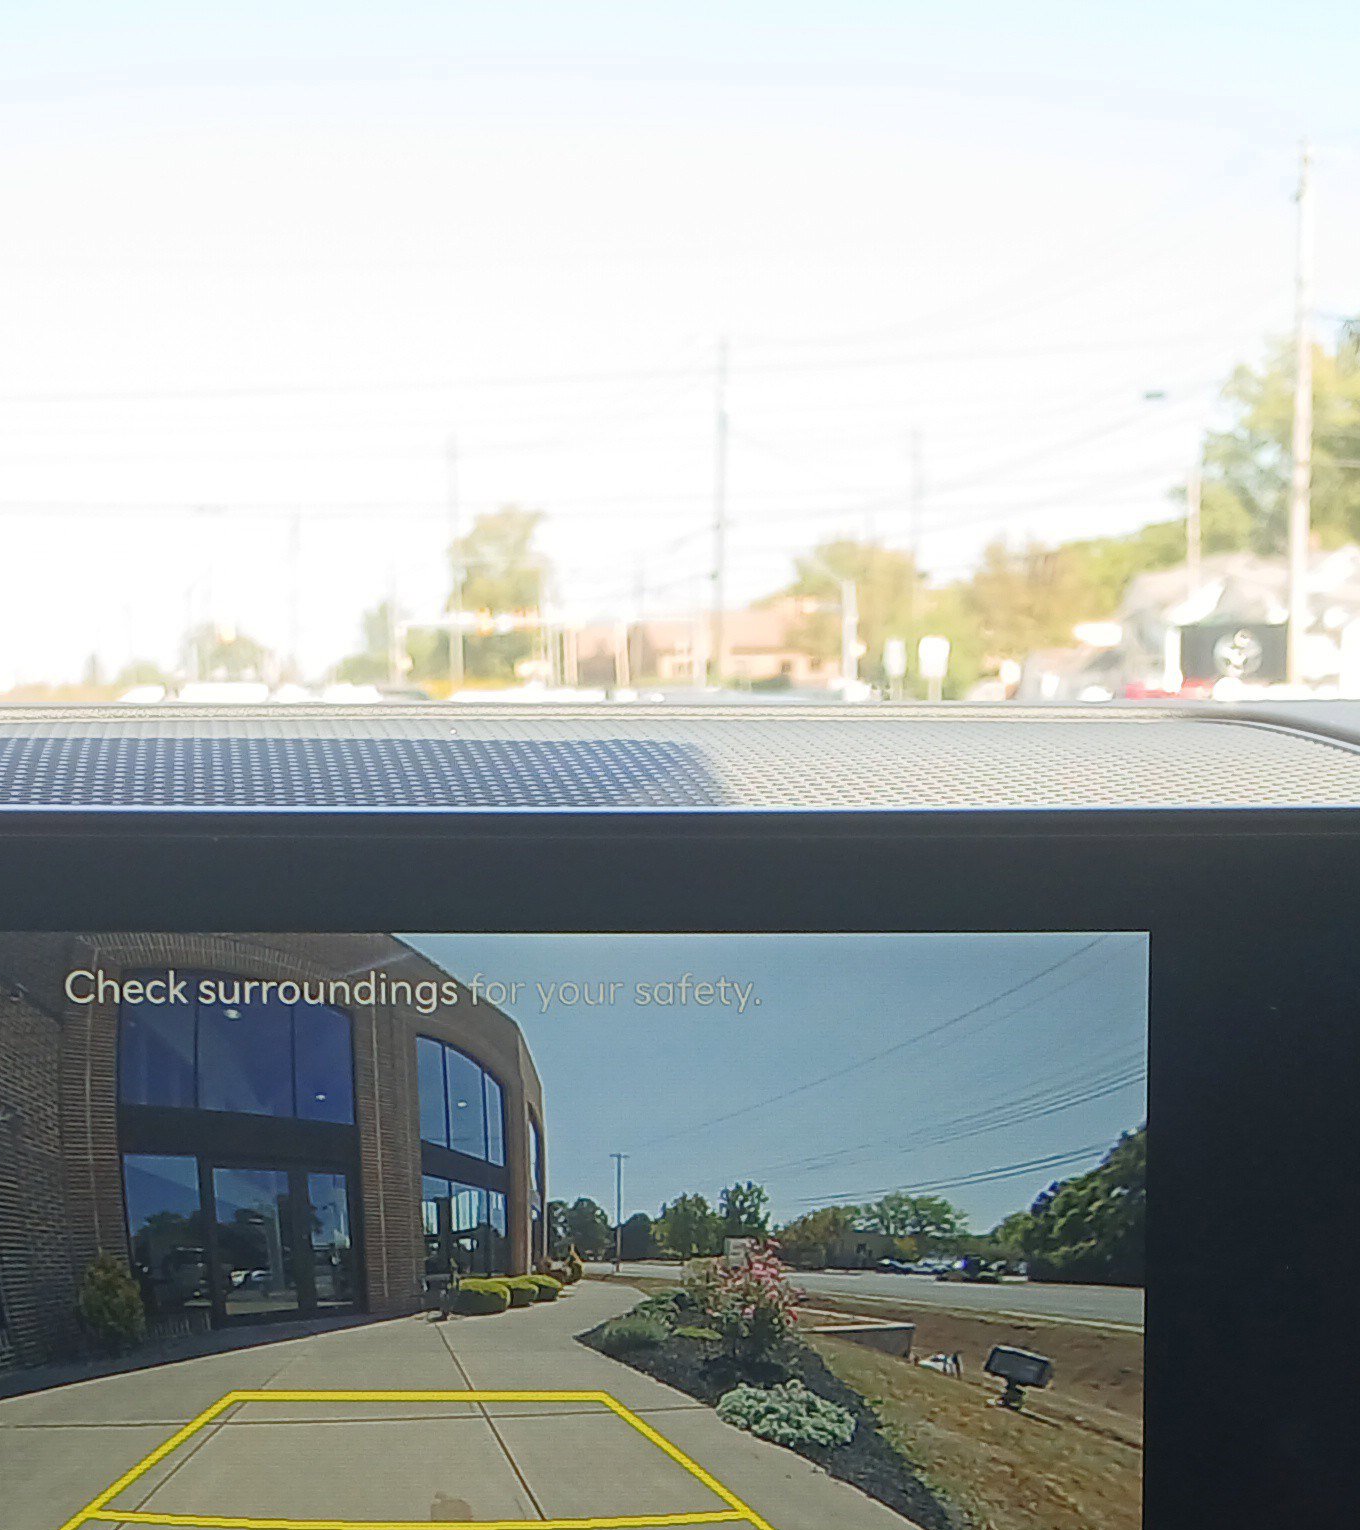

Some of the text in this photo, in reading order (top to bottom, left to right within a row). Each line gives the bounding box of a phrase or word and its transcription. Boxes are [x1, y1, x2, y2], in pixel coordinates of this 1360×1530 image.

[64, 969, 762, 1014] Check surroundings for your safety.
